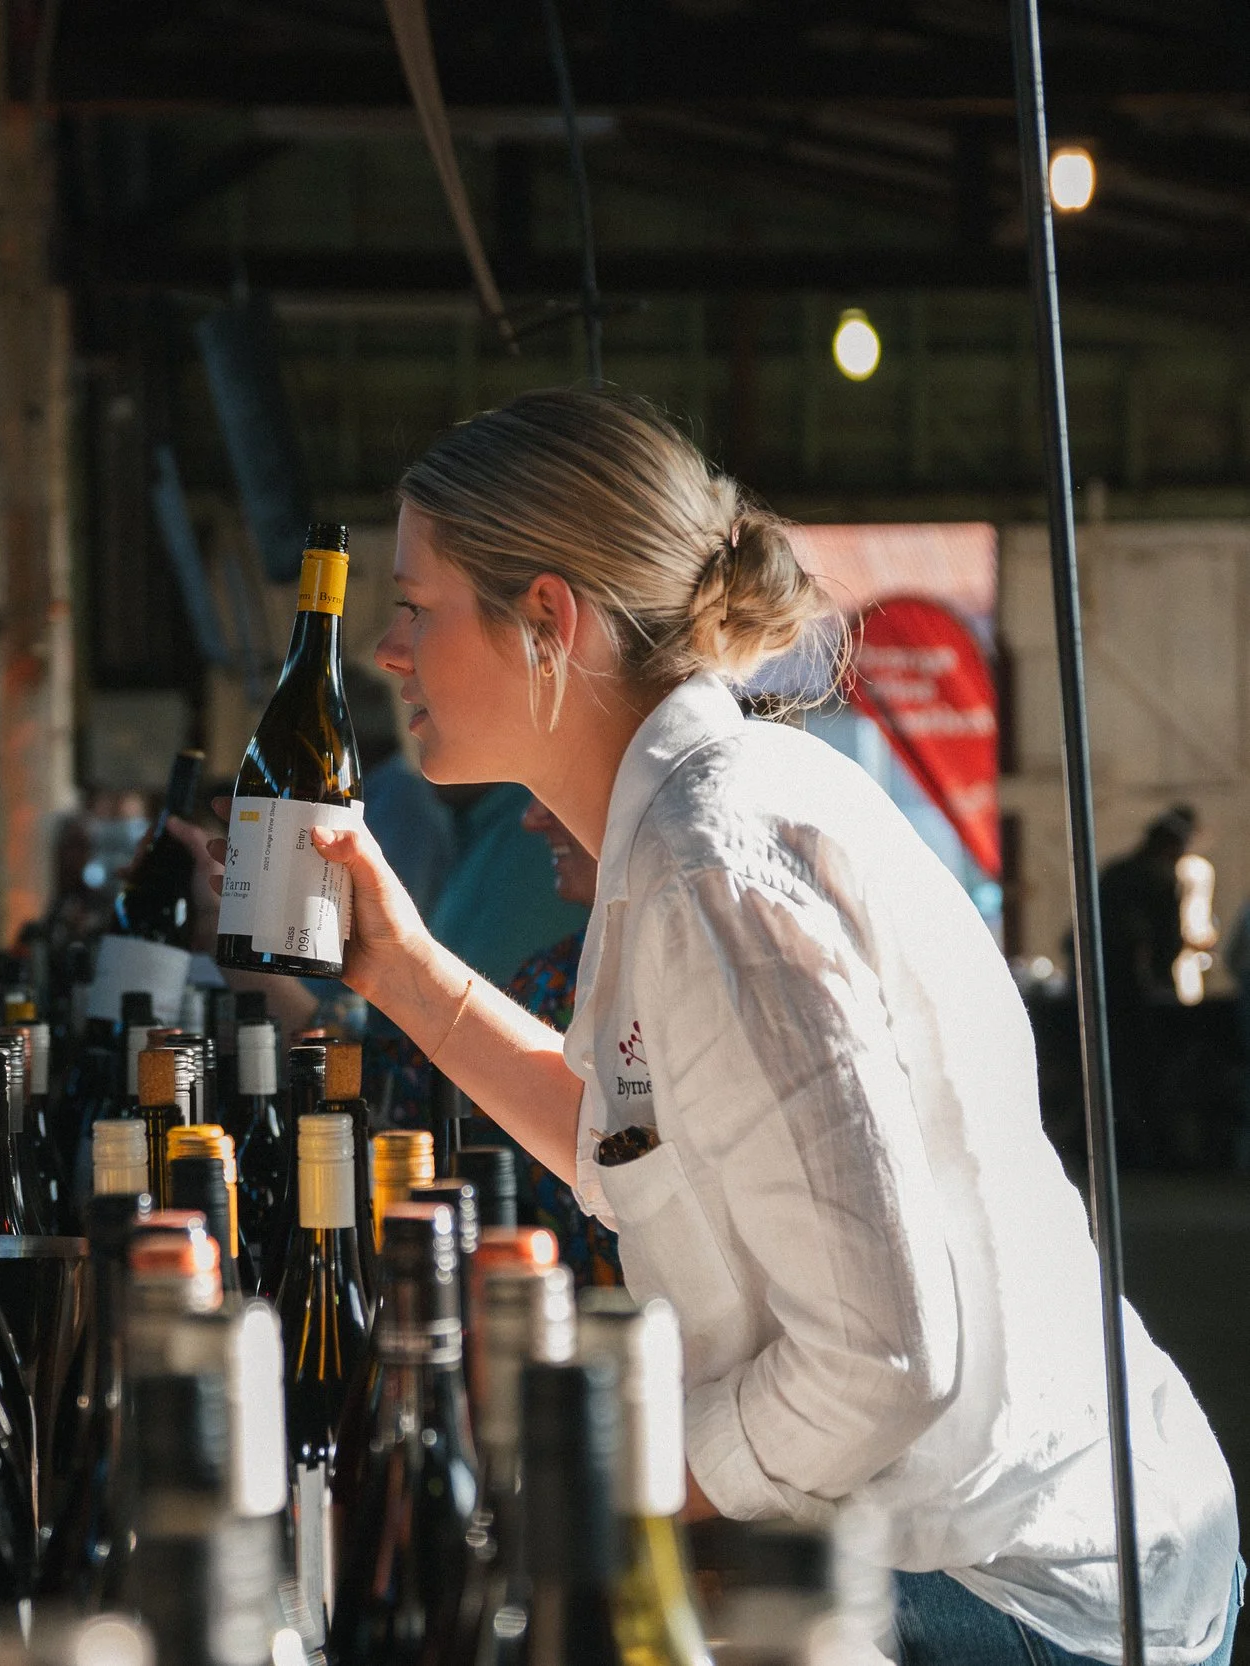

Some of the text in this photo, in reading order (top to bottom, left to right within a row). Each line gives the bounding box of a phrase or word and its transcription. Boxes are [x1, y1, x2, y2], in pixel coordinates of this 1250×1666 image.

[269, 801, 278, 817] Show
[268, 818, 276, 833] Wine
[264, 834, 275, 856] Orange
[296, 828, 308, 850] Entry
[225, 877, 251, 892] Farm
[285, 926, 295, 950] Class
[298, 927, 311, 952] 09A
